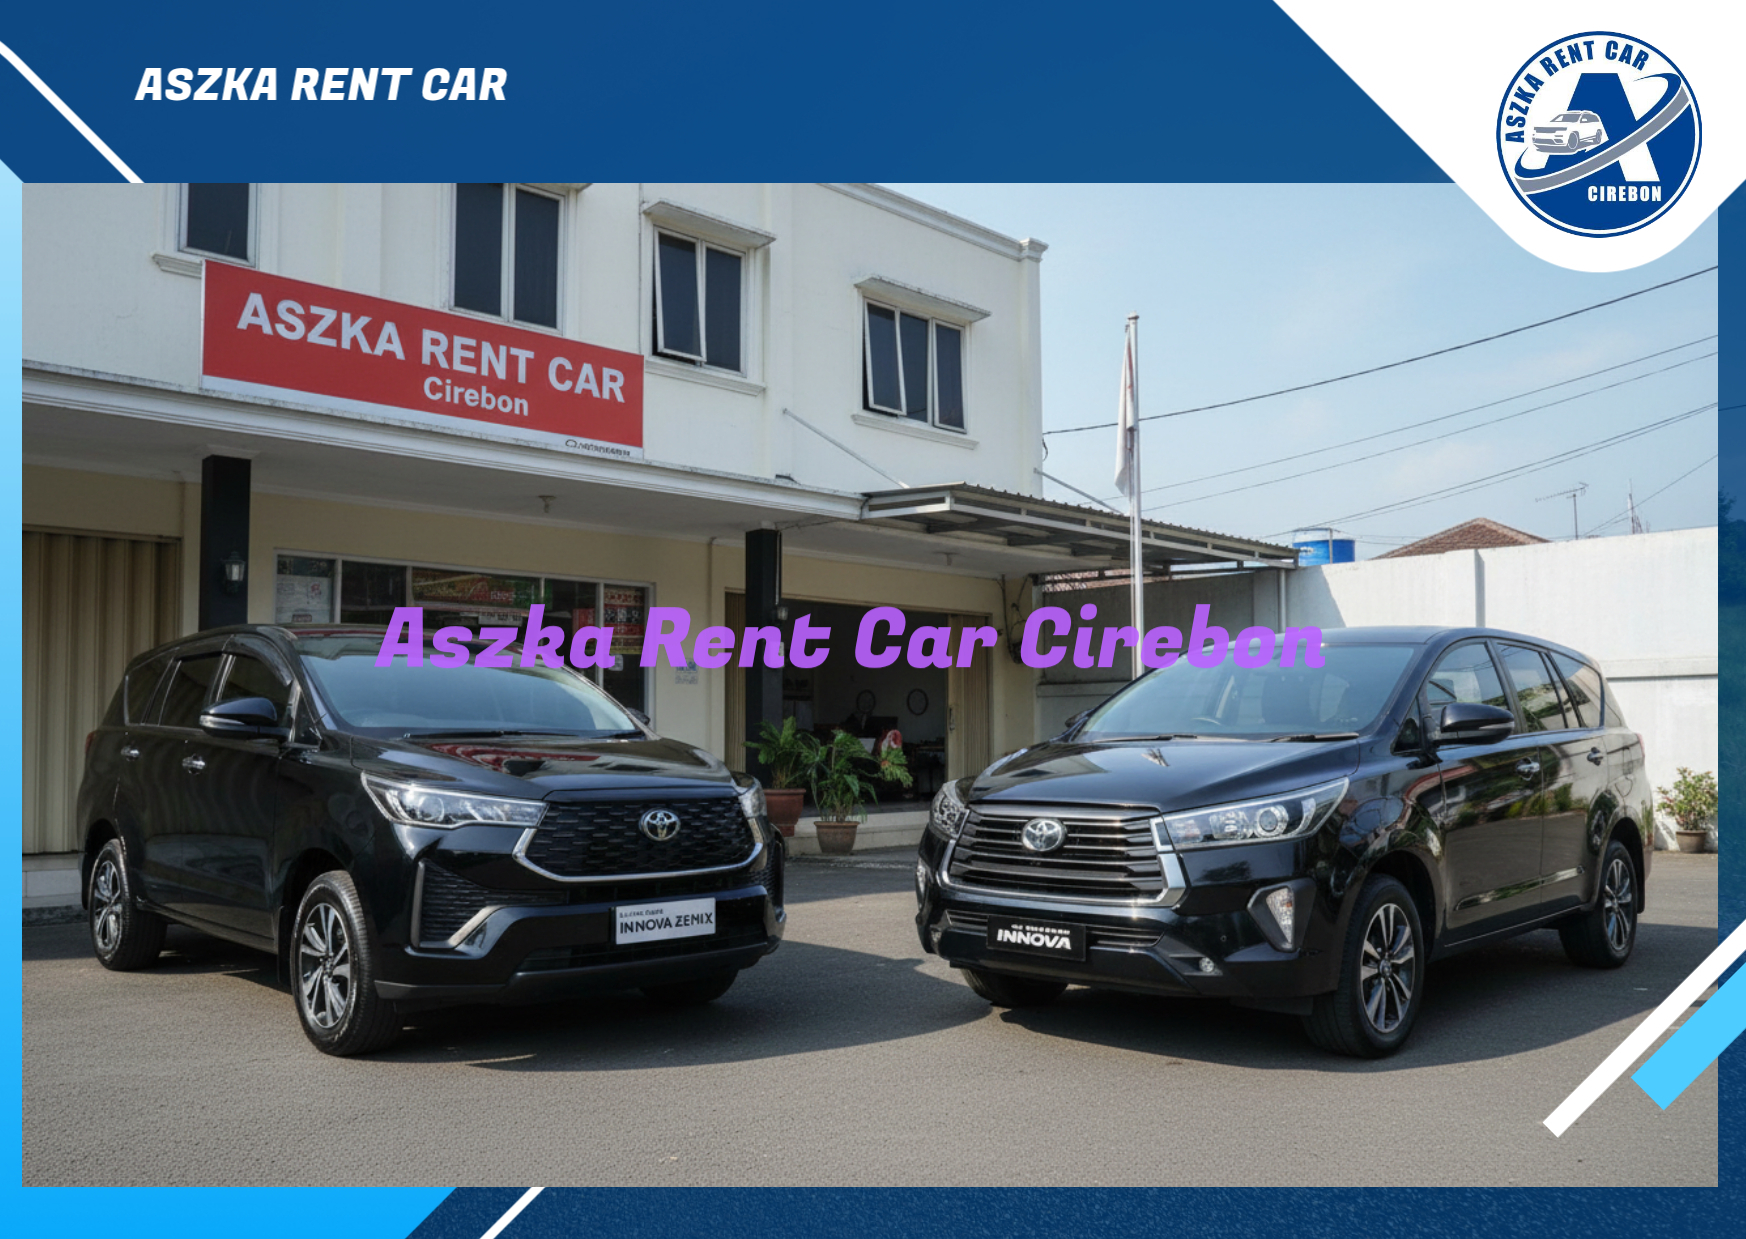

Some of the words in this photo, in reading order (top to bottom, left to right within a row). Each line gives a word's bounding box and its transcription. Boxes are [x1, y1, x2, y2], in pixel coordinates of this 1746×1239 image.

[237, 292, 405, 361] ASZKA
[421, 329, 535, 384] RENT
[548, 356, 625, 403] CAR
[423, 376, 529, 417] Cirebon
[620, 917, 673, 934] INNOVA
[997, 928, 1072, 950] INNOVA
